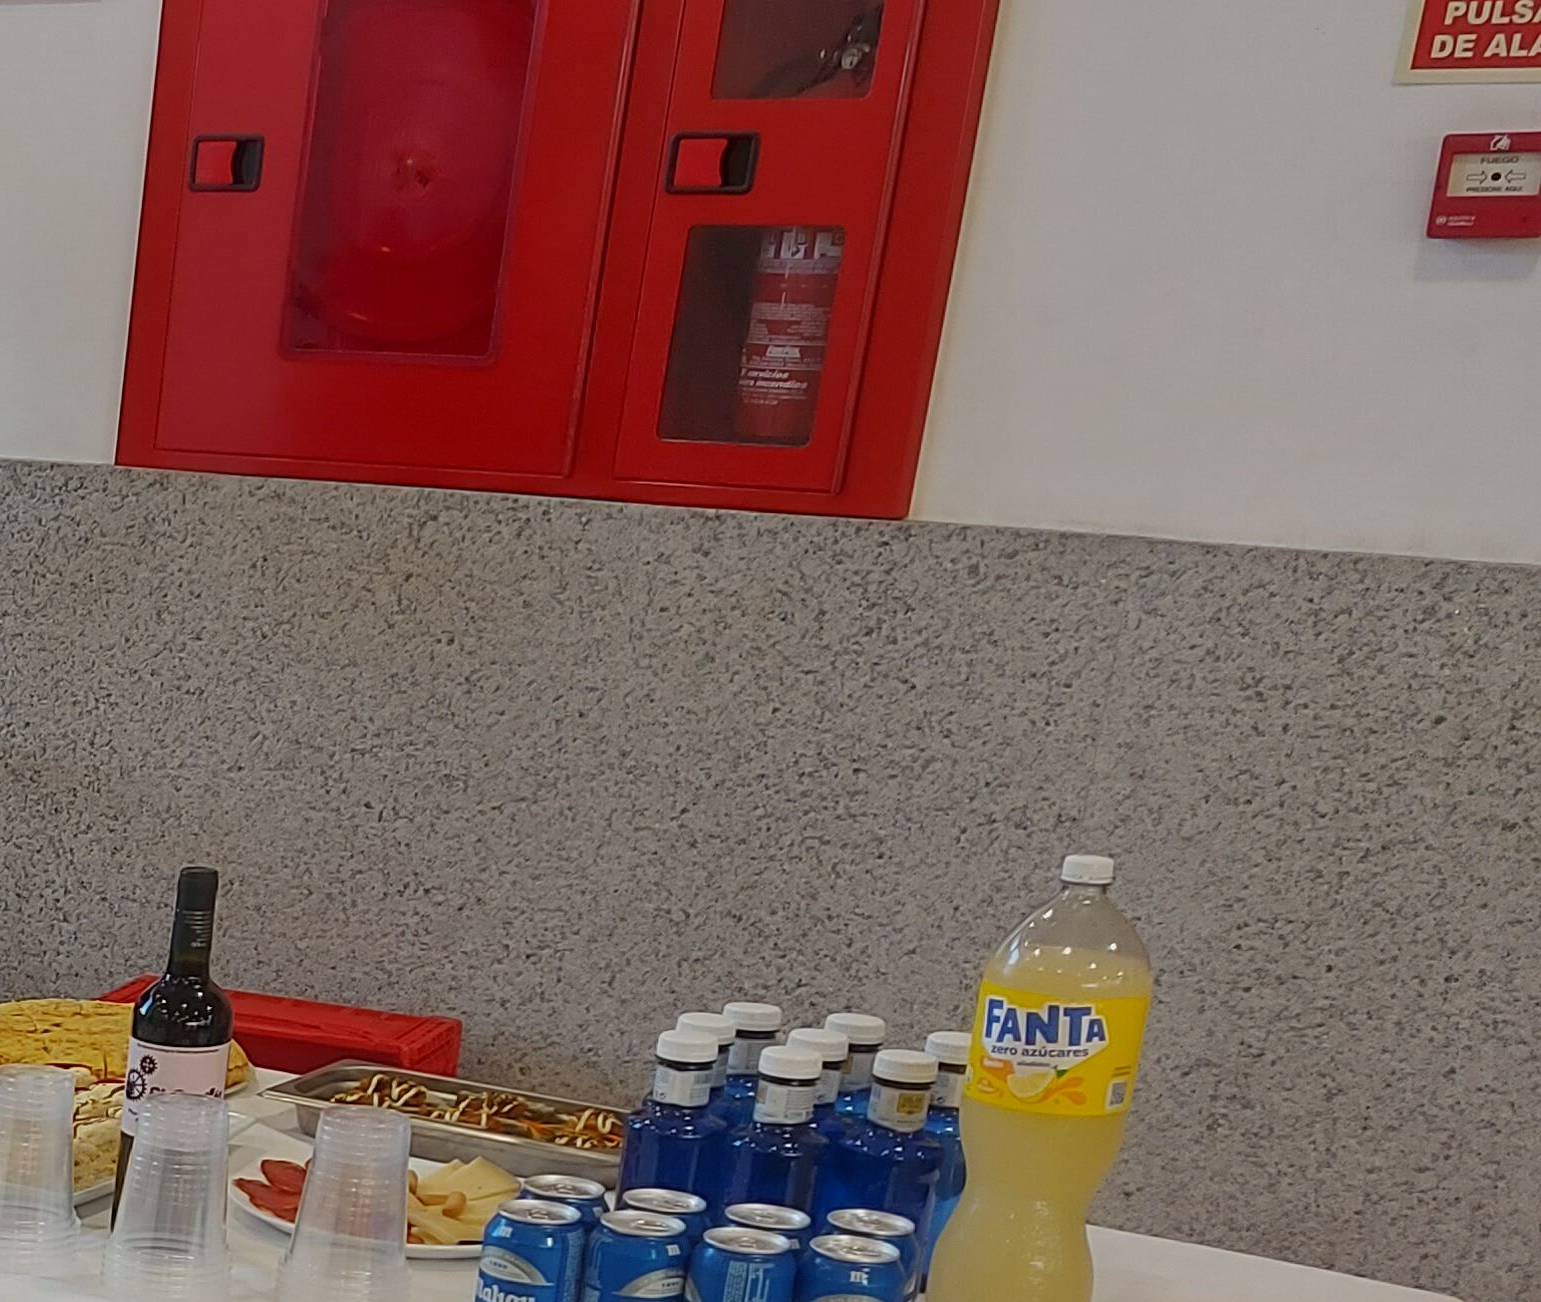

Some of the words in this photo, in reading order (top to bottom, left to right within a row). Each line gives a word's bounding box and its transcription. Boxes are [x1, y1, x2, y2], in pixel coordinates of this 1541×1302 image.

[1430, 34, 1477, 58] DE
[1480, 156, 1519, 164] FUEGO
[985, 998, 1107, 1047] FANTA
[991, 1045, 1018, 1055] zero
[1021, 1045, 1089, 1058] azúcares
